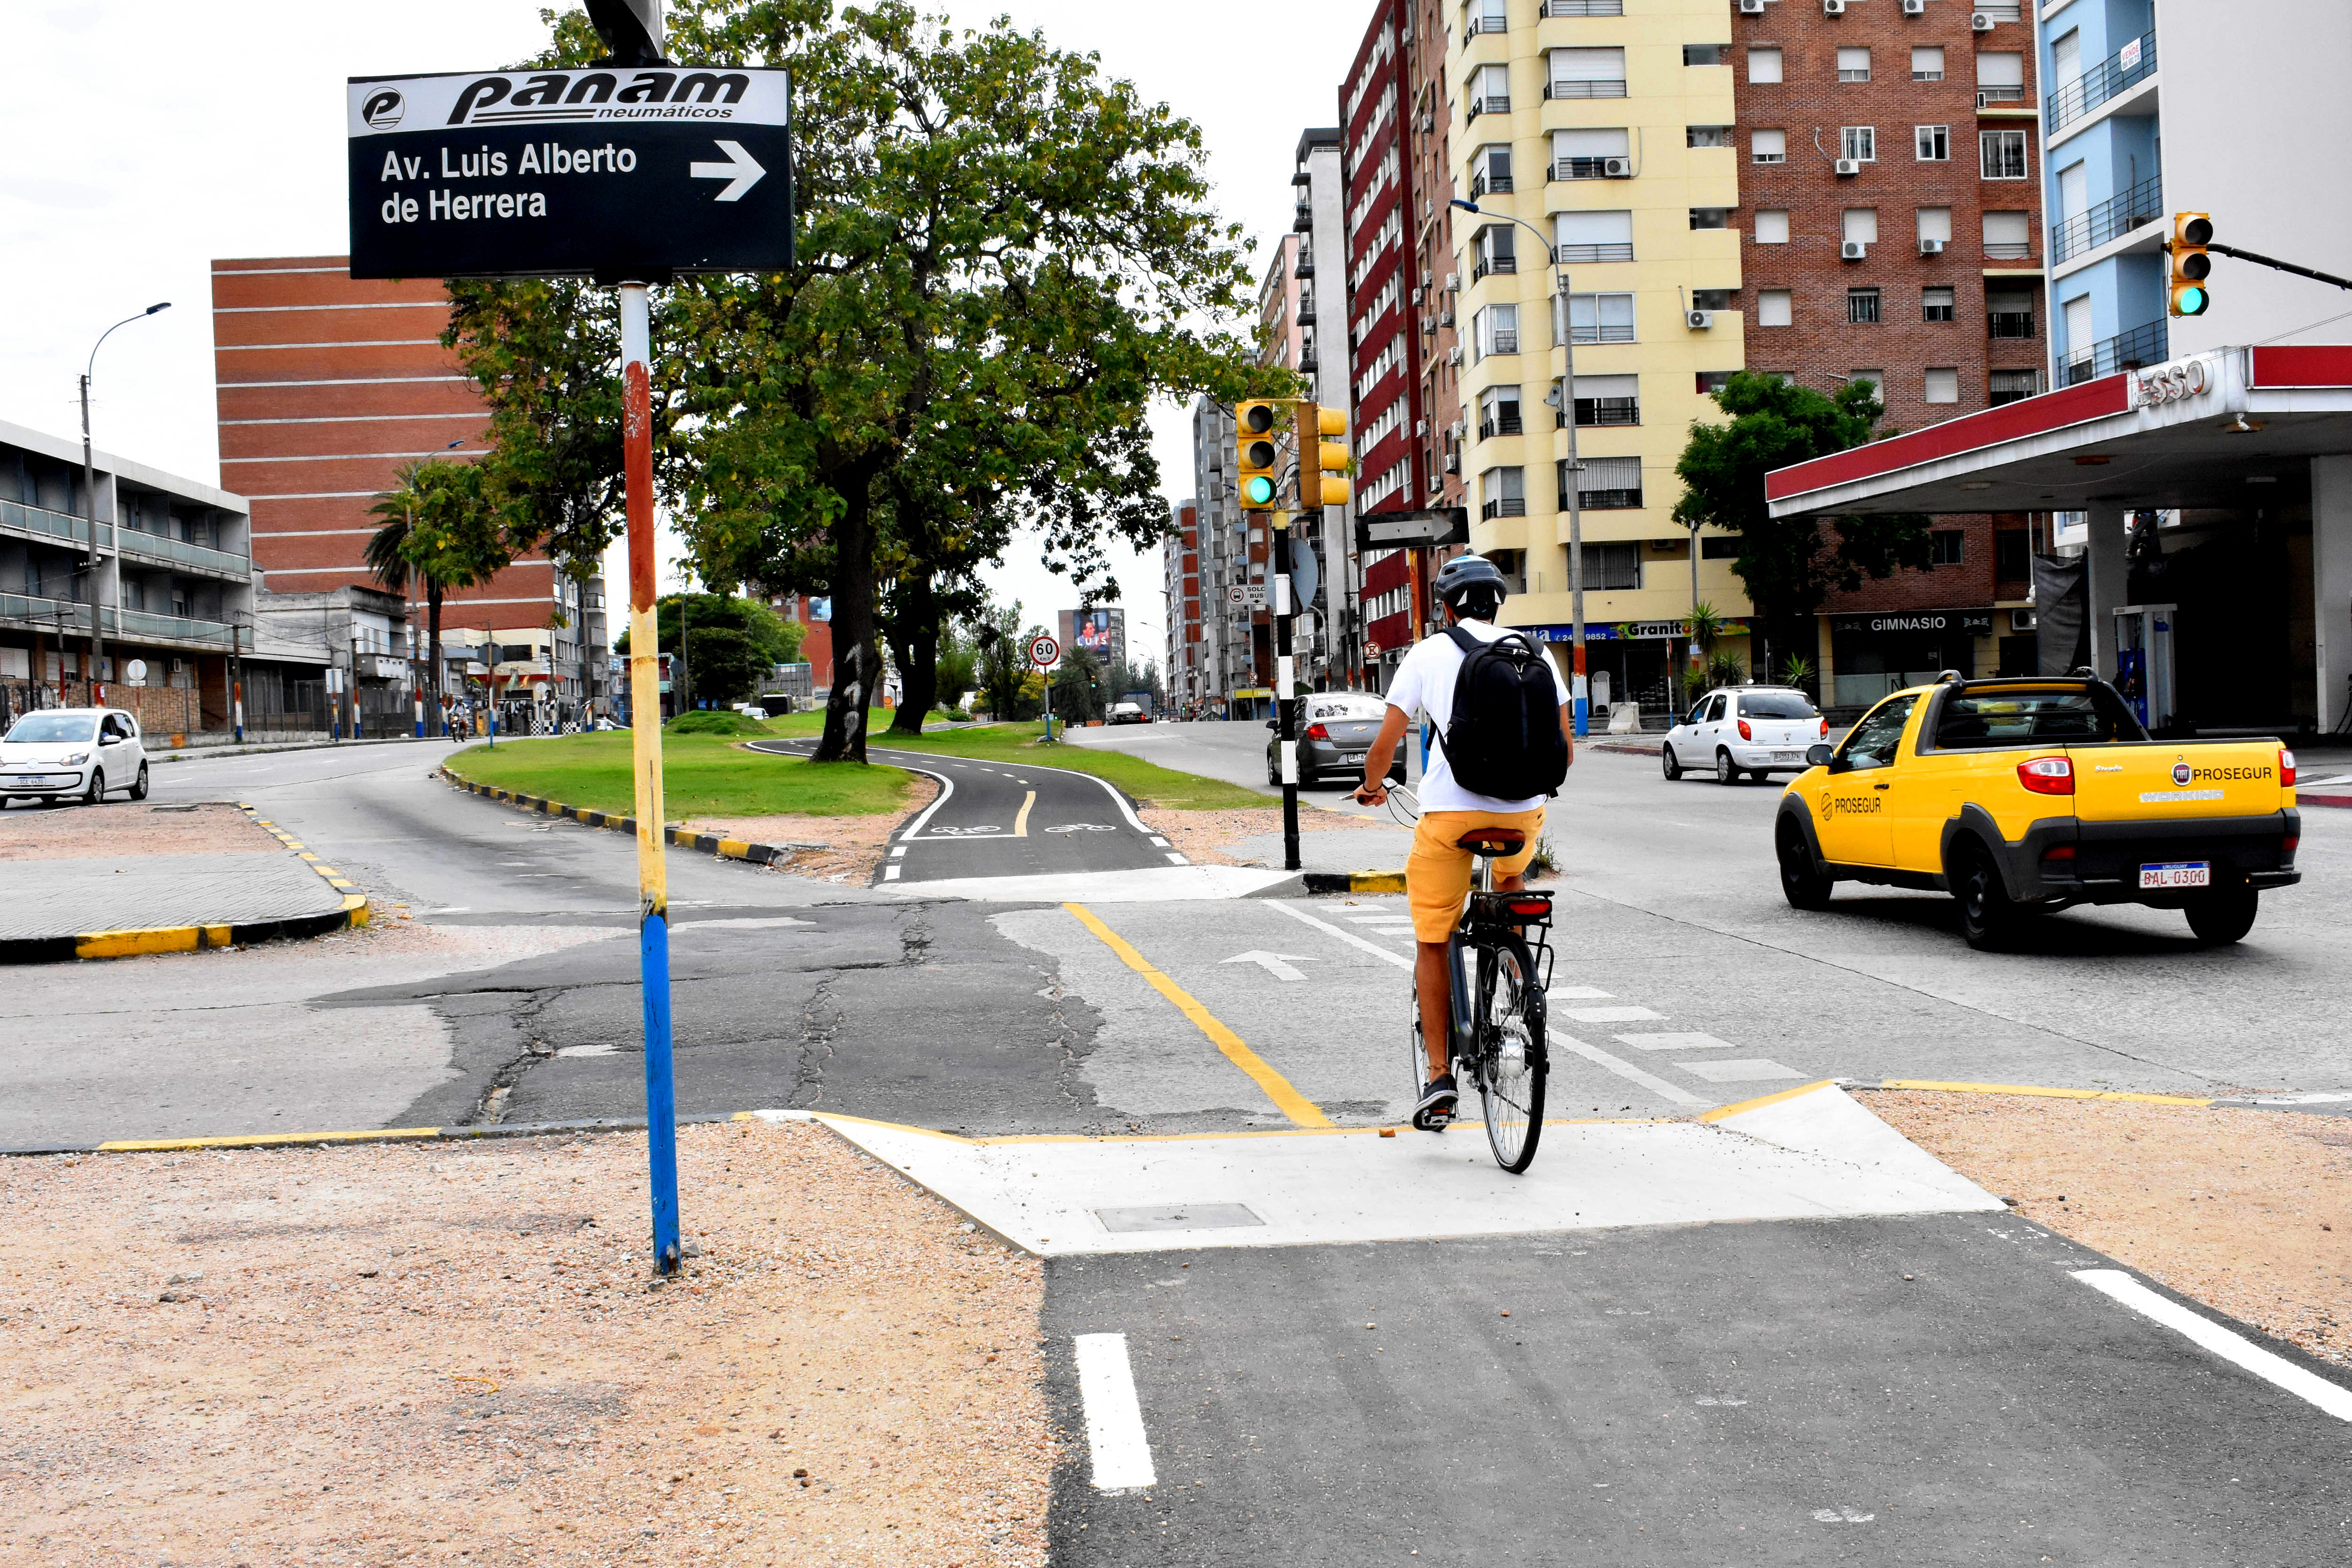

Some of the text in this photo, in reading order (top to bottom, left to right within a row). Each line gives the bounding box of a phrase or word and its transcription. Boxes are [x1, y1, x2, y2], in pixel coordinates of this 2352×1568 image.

[2122, 45, 2139, 61] VENDE
[599, 105, 733, 120] neumáticos
[381, 143, 637, 182] Av. Luis Alberto
[382, 190, 546, 224] de Herrera
[1871, 617, 1946, 631] GIMNASIO
[1036, 643, 1053, 655] 60
[1077, 637, 1107, 646] LUIS
[2176, 769, 2188, 780] FIAT
[2193, 767, 2272, 780] PROSEGUR
[1835, 797, 1881, 813] PROSEGUR
[2144, 870, 2205, 885] BAL 0300
